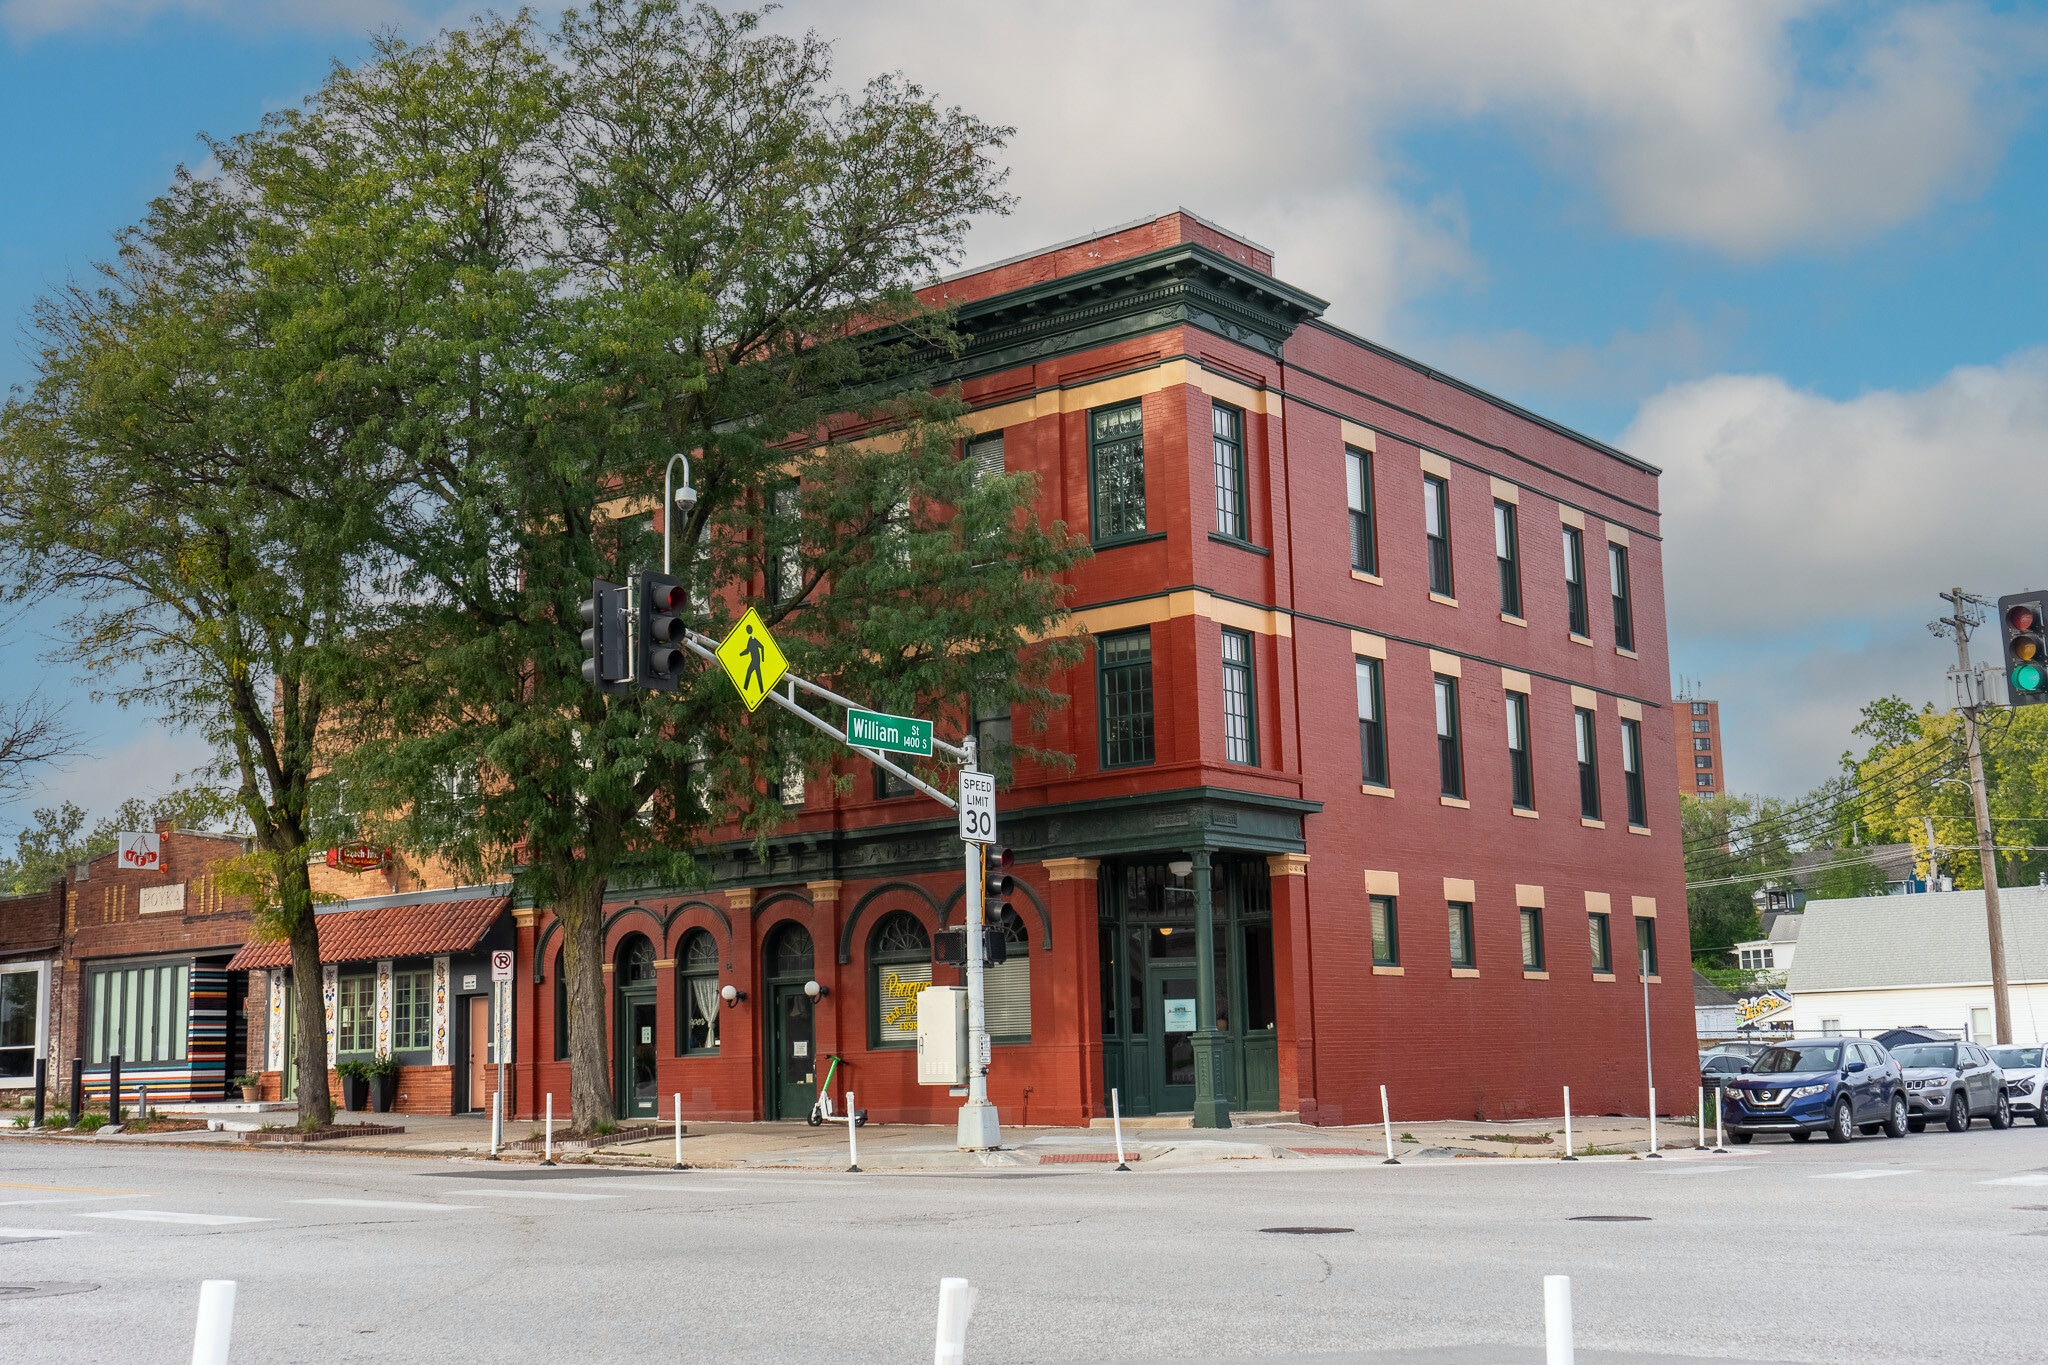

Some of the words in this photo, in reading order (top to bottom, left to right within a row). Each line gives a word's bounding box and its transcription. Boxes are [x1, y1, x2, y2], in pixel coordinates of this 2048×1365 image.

[853, 717, 899, 744] William
[911, 725, 920, 736] St
[903, 735, 920, 748] 1400
[922, 739, 927, 750] S
[963, 778, 992, 793] SPEED
[967, 794, 989, 808] LIMIT
[966, 809, 991, 836] 30
[852, 839, 949, 863] SAMPLE
[143, 888, 180, 908] ROYKA
